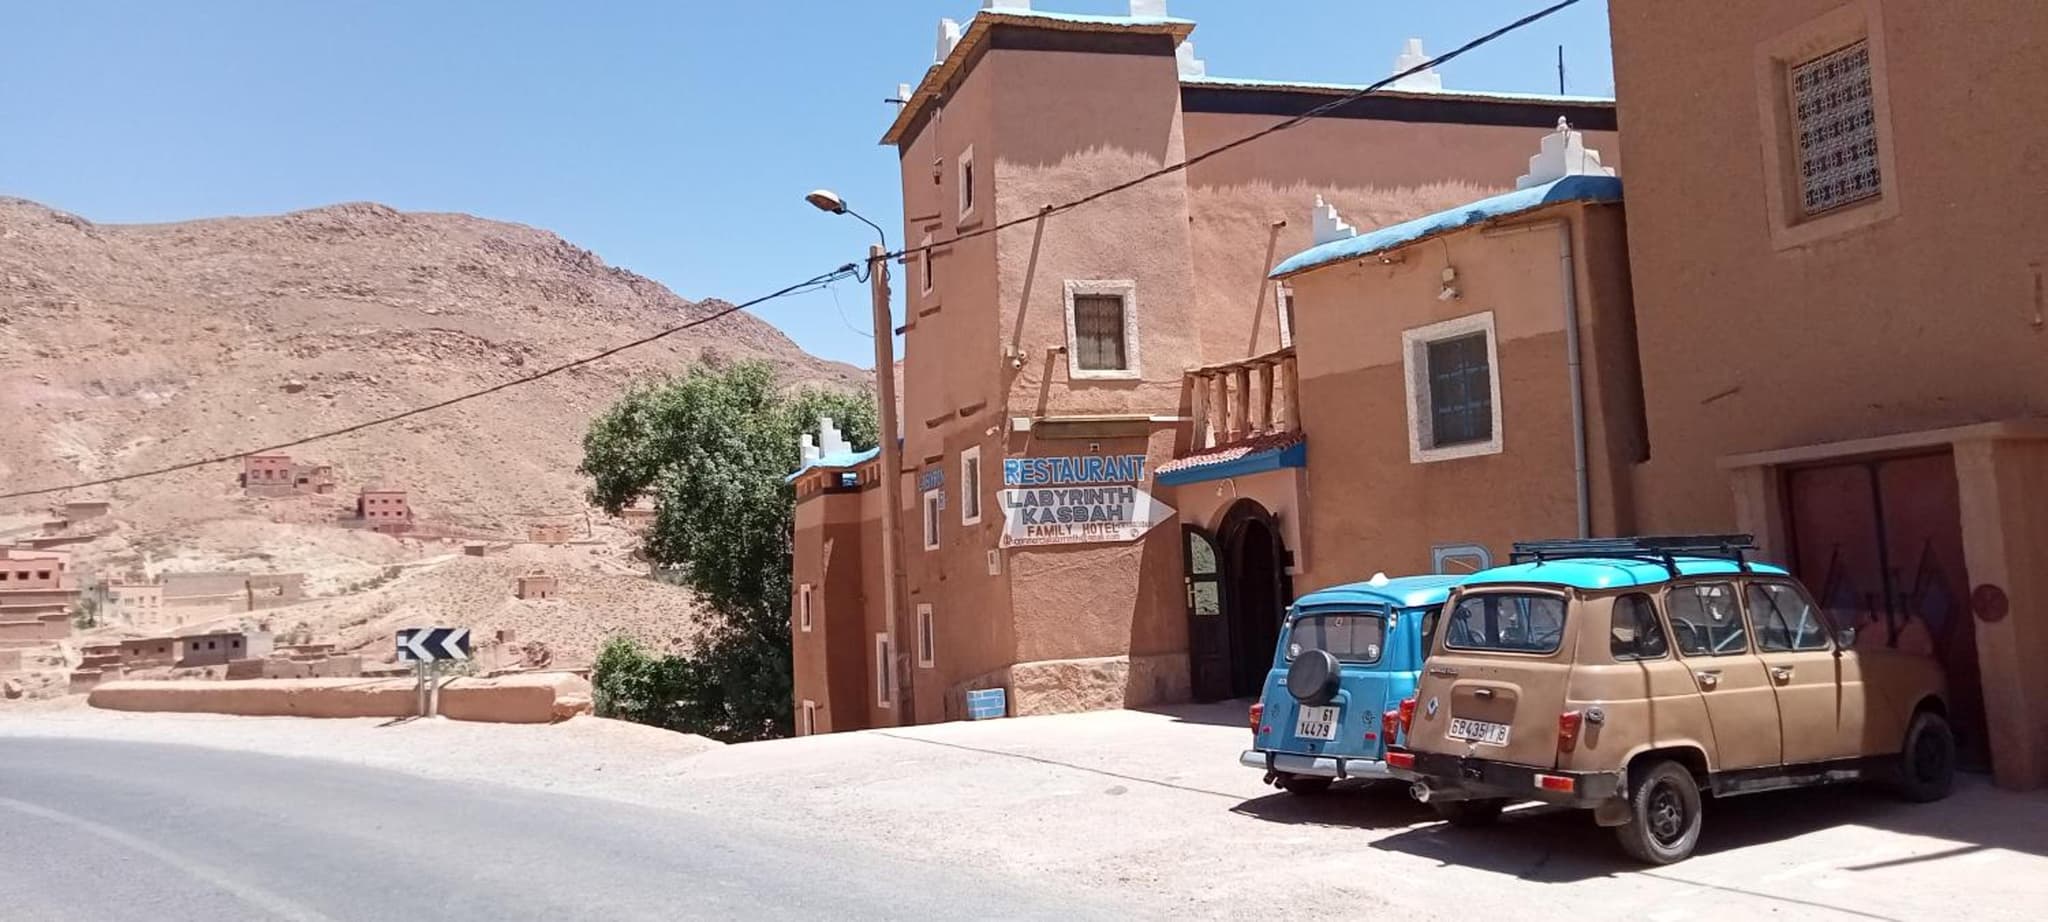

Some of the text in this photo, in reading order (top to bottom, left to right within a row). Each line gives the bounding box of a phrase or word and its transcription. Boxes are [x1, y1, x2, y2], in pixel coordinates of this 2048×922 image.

[1004, 453, 1146, 485] RESTAURANT
[1007, 487, 1134, 508] LABYRINTH
[1021, 504, 1123, 525] KASBAH
[1027, 523, 1073, 537] FAMILY
[1082, 521, 1119, 535] HOTEL
[1300, 722, 1330, 737] 14479
